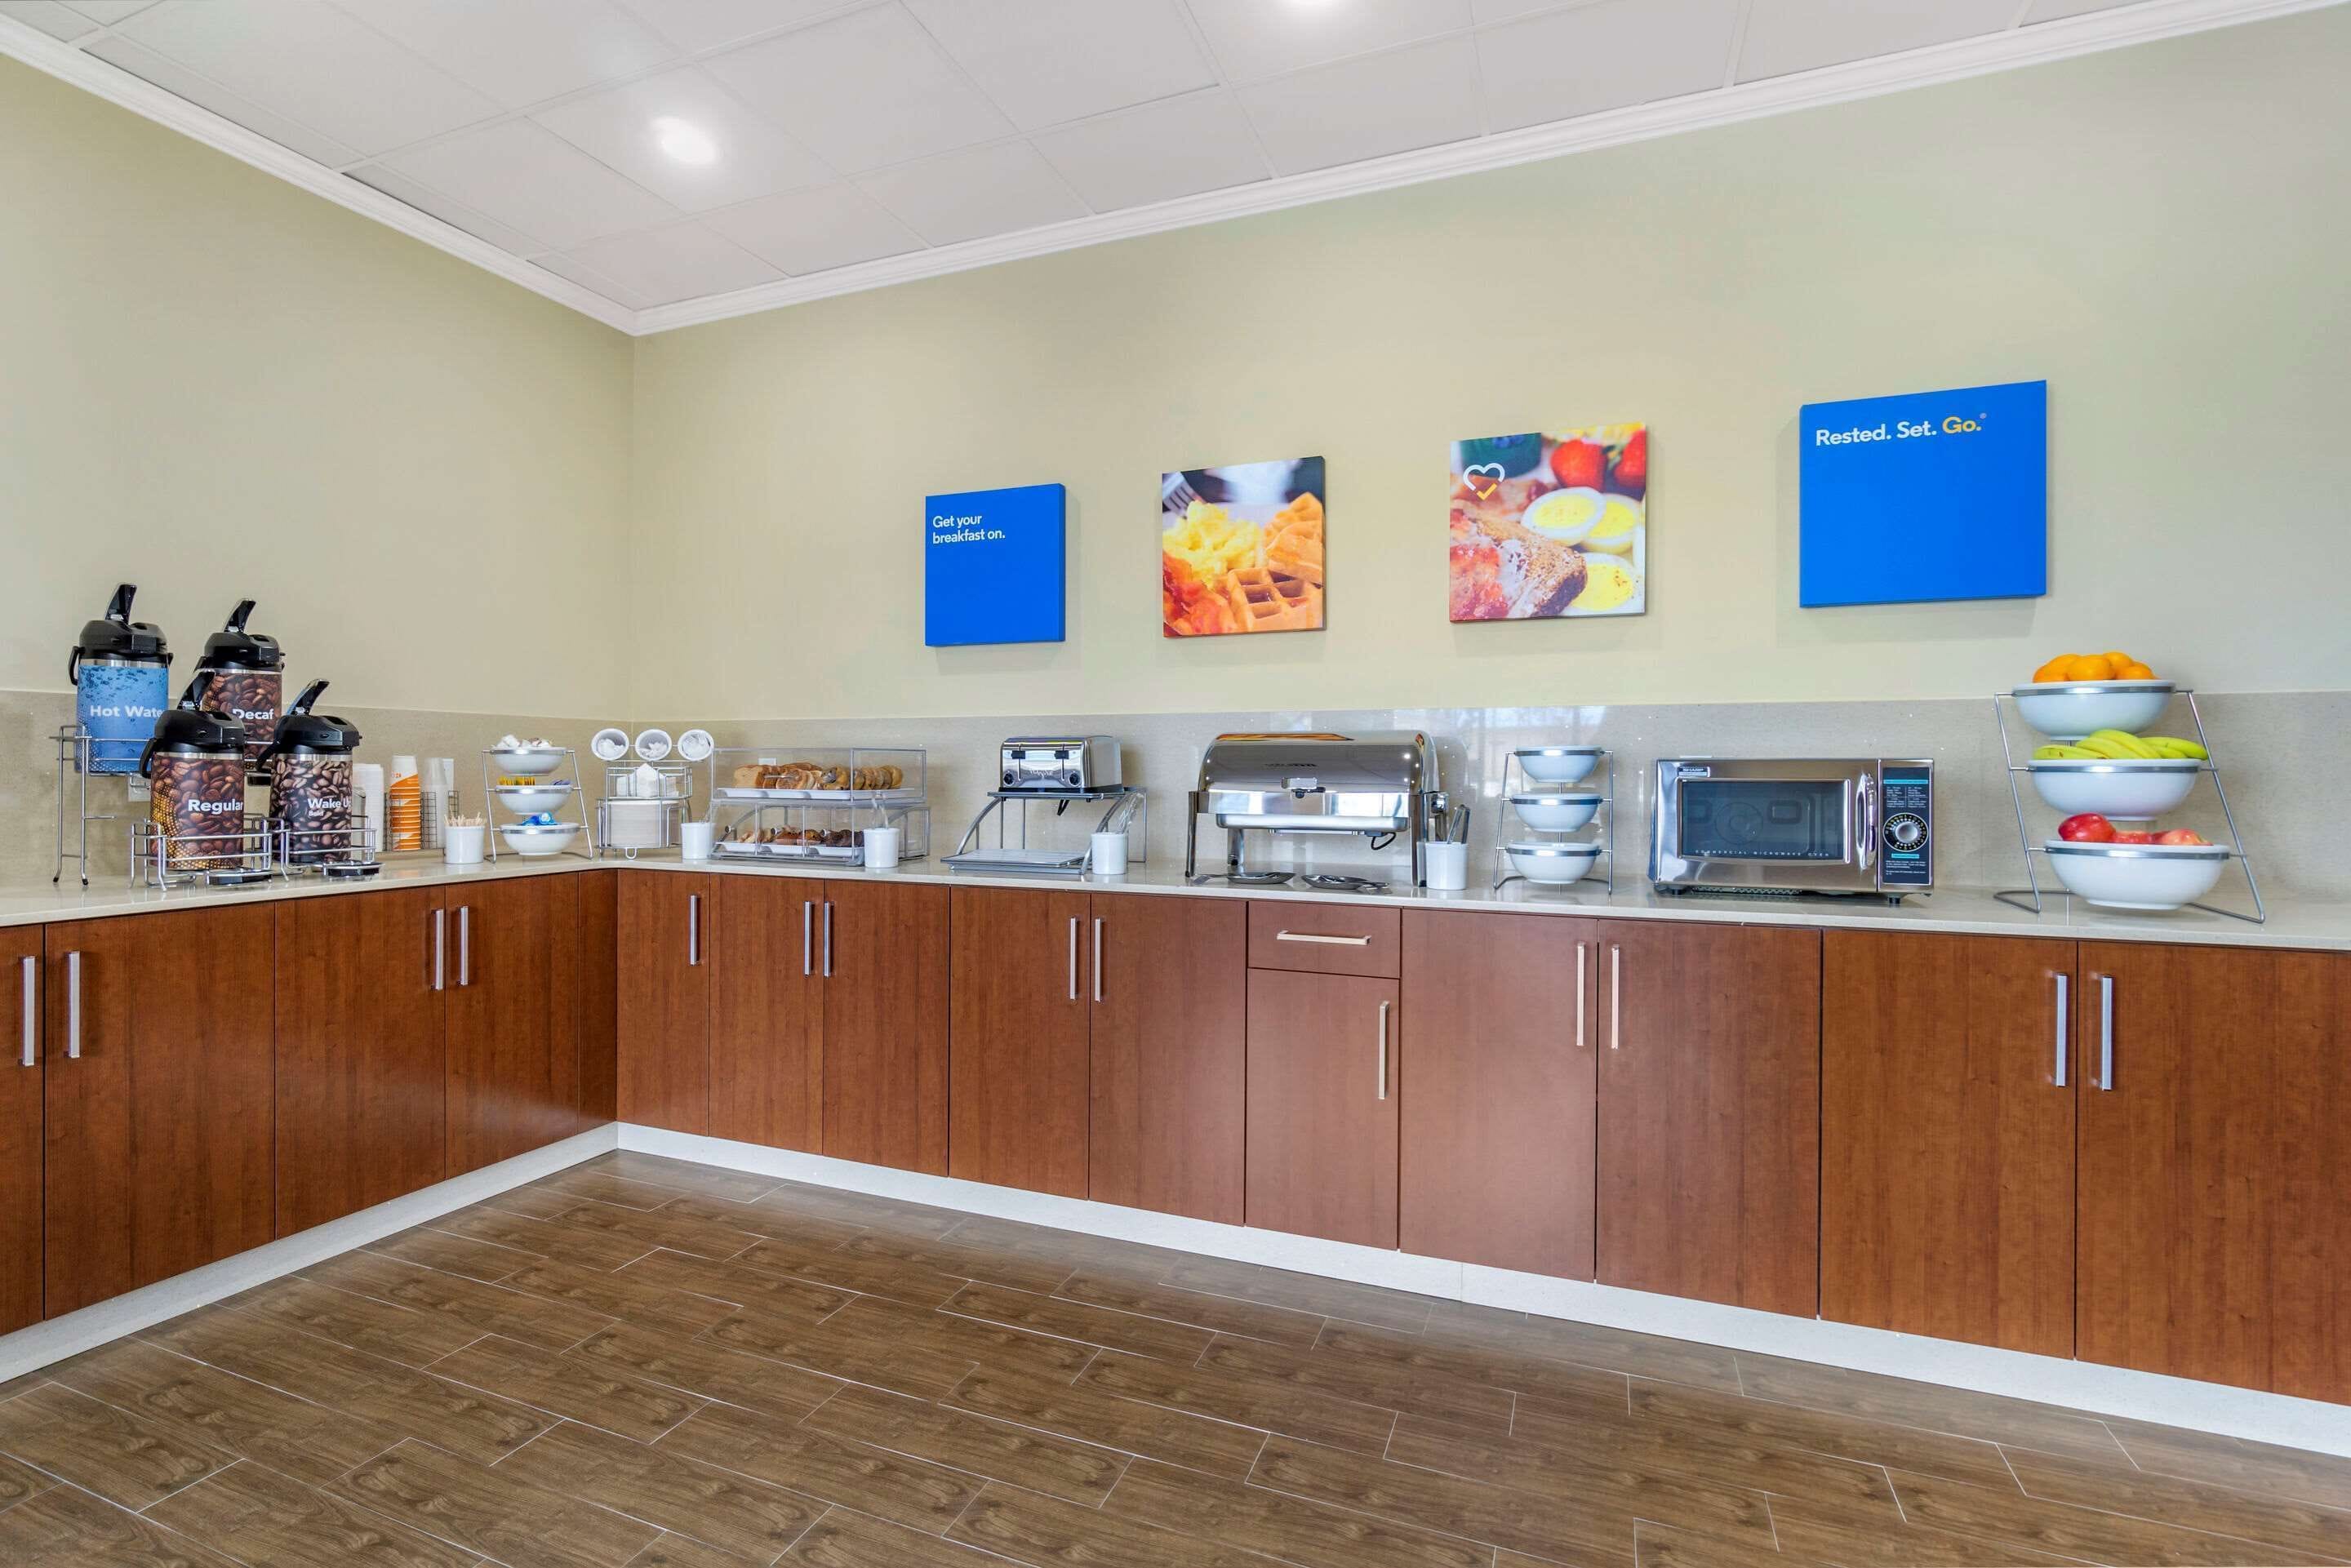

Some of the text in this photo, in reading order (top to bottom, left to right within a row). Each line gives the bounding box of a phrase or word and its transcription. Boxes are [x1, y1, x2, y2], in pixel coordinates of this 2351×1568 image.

[1815, 424, 1891, 446] Rested.
[1896, 420, 1937, 438] Set.
[932, 515, 983, 529] Get your
[932, 528, 1006, 544] breakfast on.
[90, 704, 165, 718] Hot Wate
[232, 708, 274, 720] Decaf
[188, 798, 243, 815] Regular
[307, 797, 342, 809] Wake
